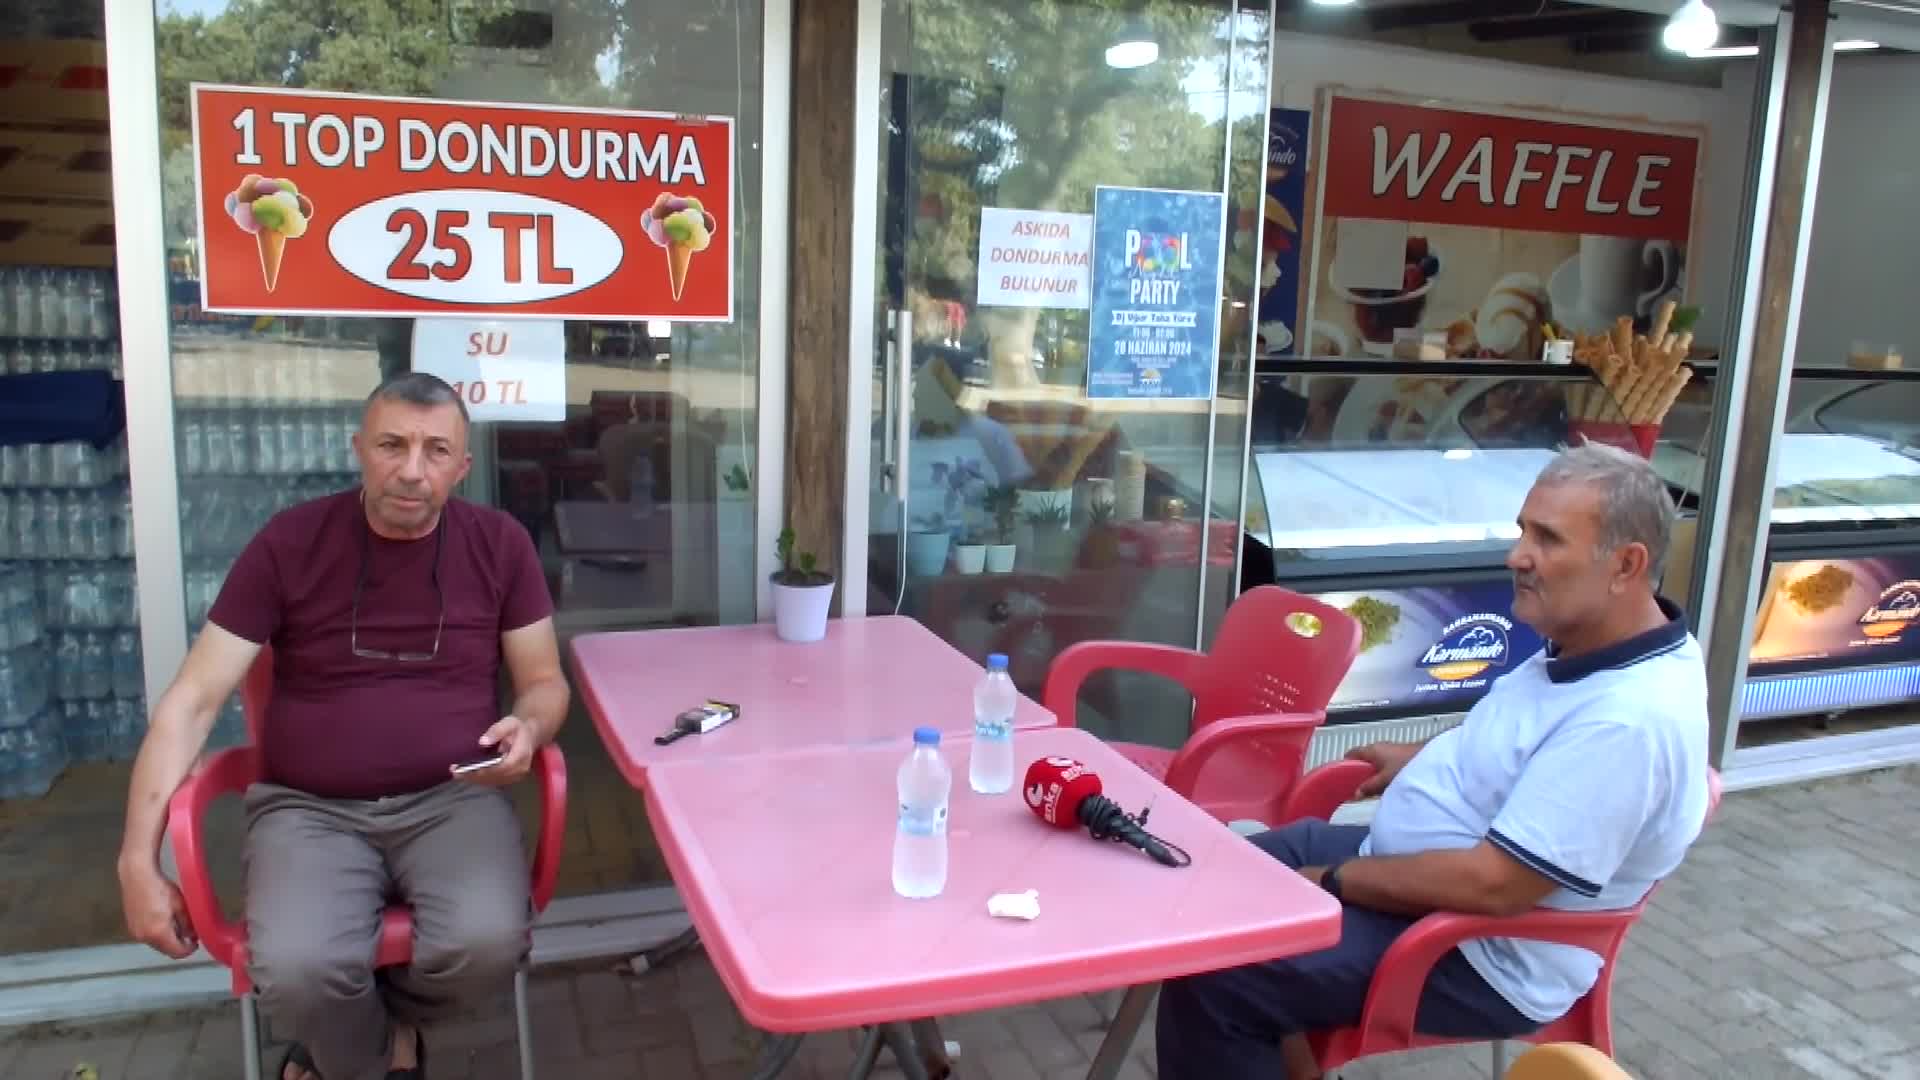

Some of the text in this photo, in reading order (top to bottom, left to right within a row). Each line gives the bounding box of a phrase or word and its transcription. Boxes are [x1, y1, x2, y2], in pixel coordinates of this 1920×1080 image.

[232, 108, 707, 185] 1 TOP DONDURMA
[1372, 125, 1672, 218] WAFFLE
[1011, 221, 1070, 239] ASKIDA
[385, 207, 575, 284] 25 TL
[990, 247, 1088, 266] DONDURMA
[1000, 275, 1078, 293] BULUNUR
[1130, 279, 1180, 305] PARTY
[466, 331, 508, 356] SU
[1168, 340, 1192, 356] 2024
[496, 381, 528, 404] TL
